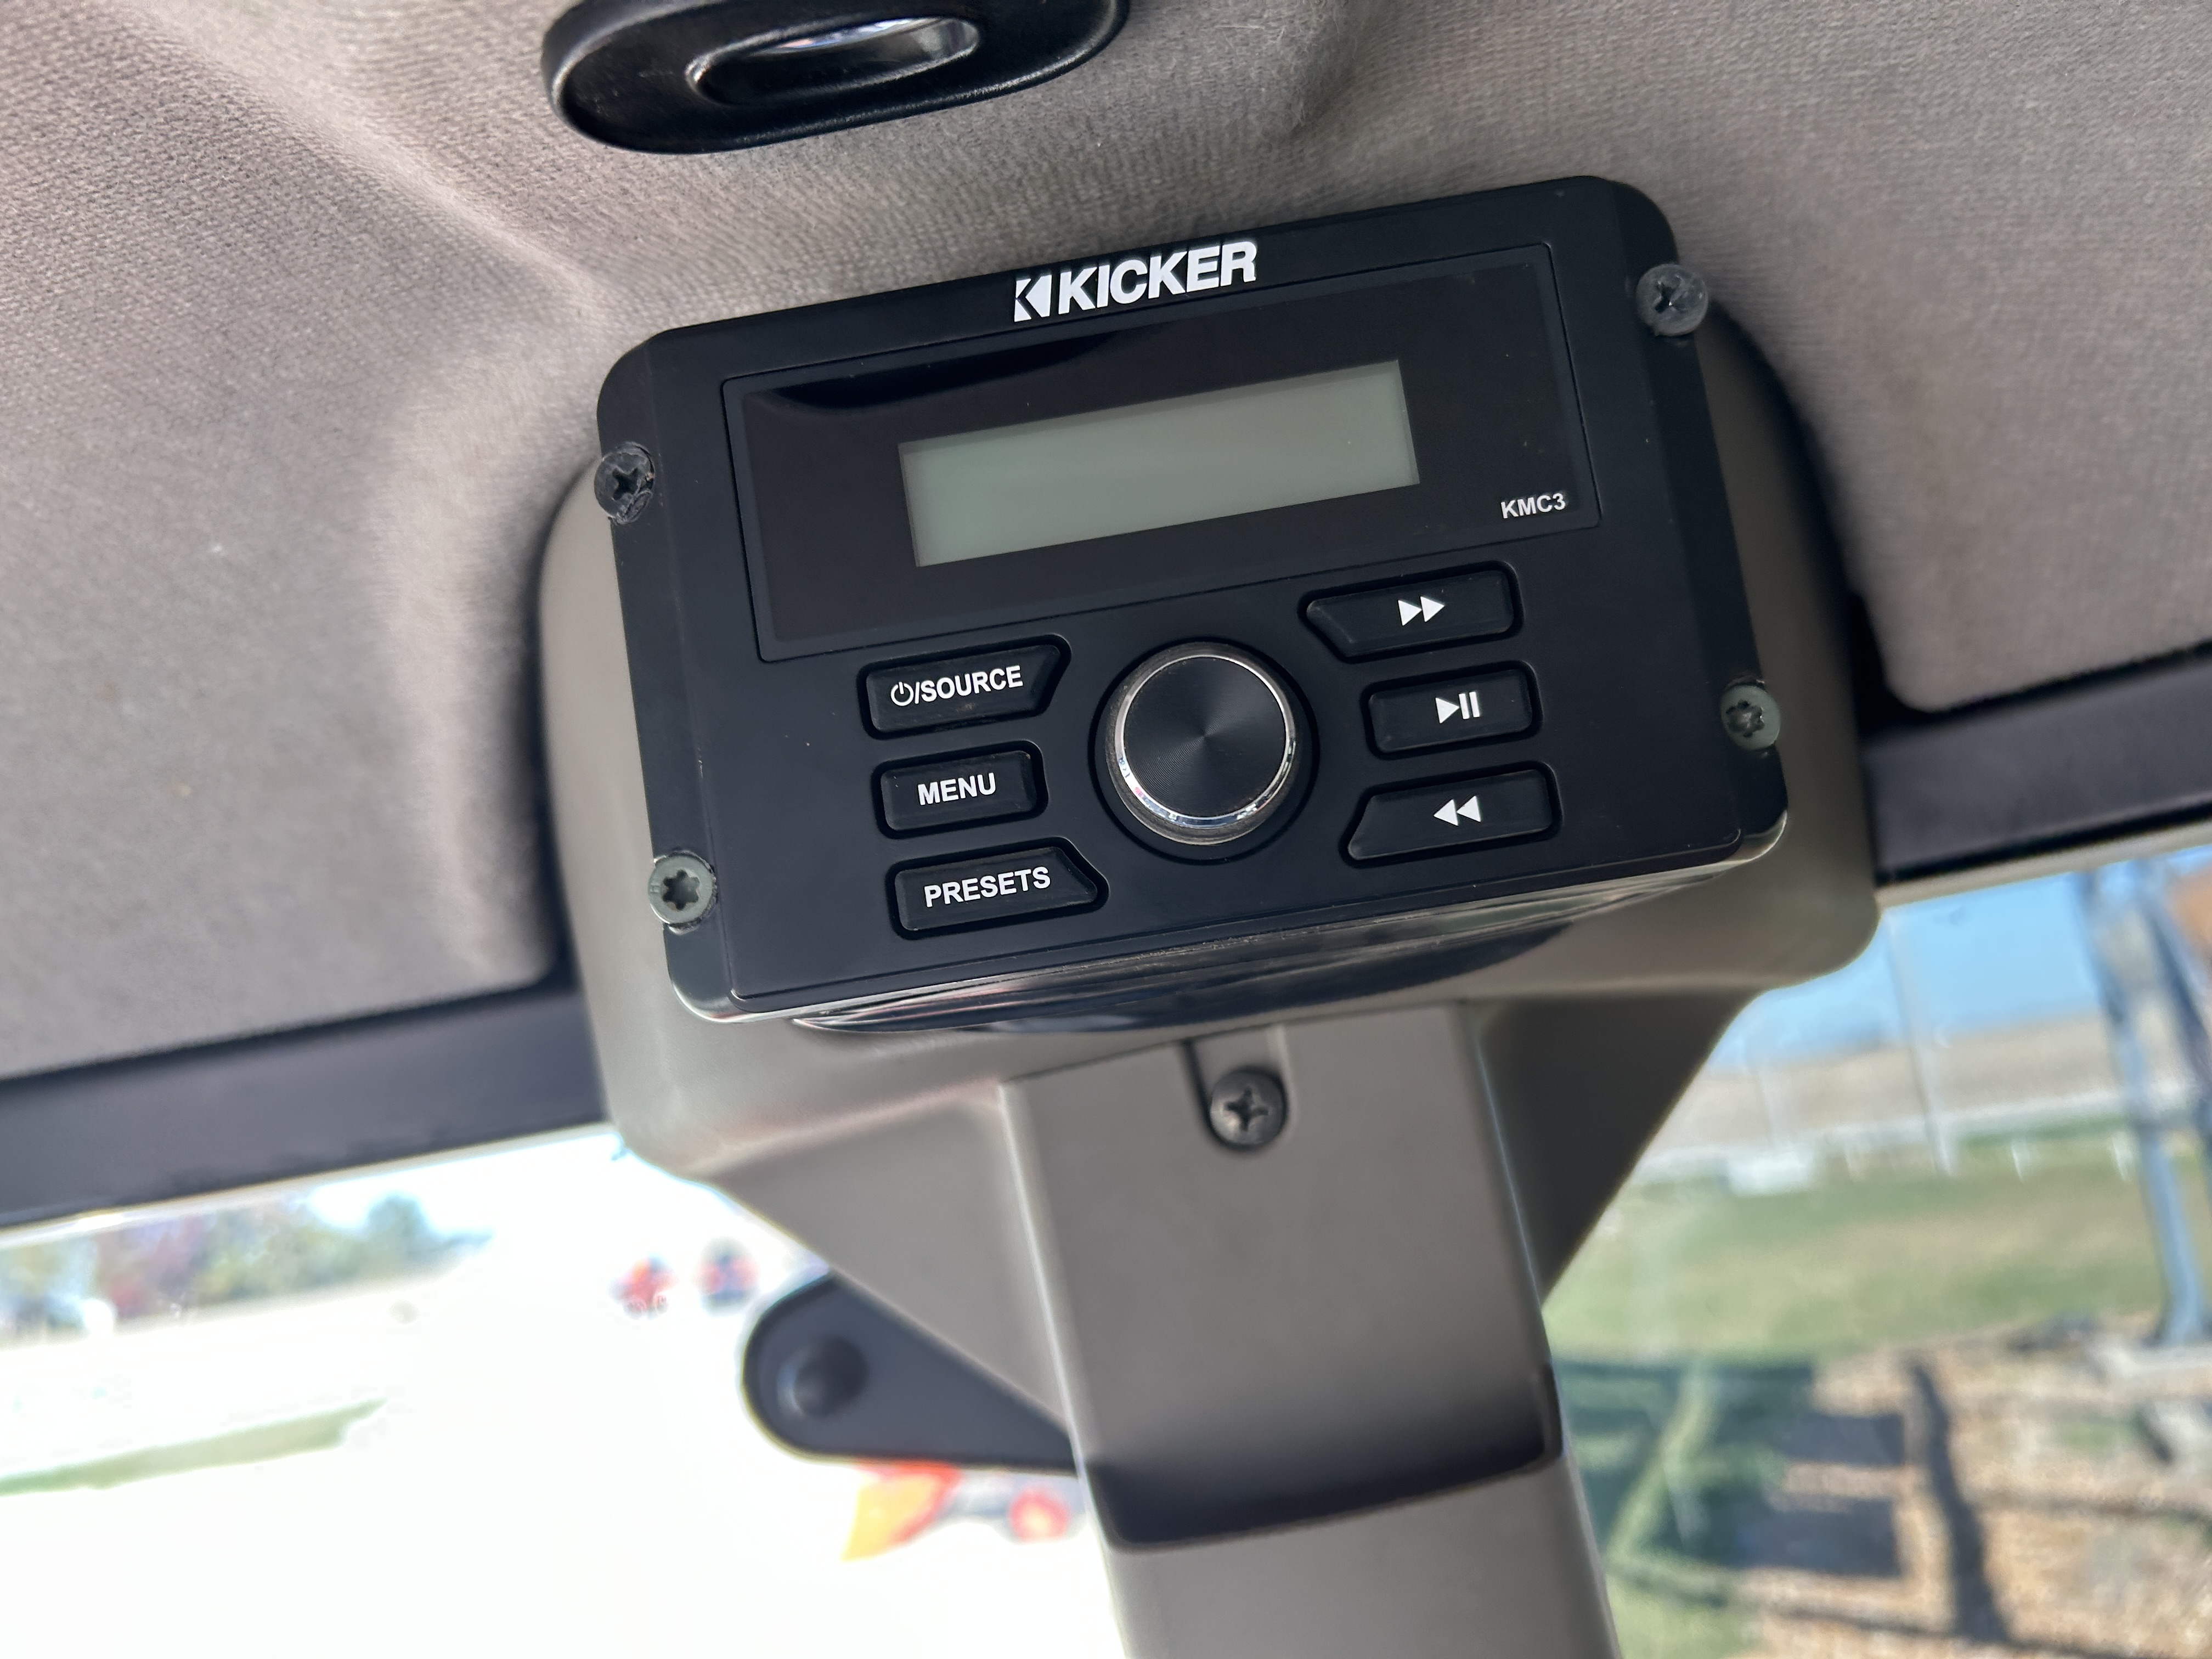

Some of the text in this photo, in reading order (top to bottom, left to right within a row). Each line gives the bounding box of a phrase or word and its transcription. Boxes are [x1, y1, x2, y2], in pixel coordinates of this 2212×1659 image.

[1058, 240, 1257, 315] KICKER
[1500, 493, 1567, 519] KMC3
[917, 772, 996, 806] MENU
[924, 866, 1051, 907] PRESETS
